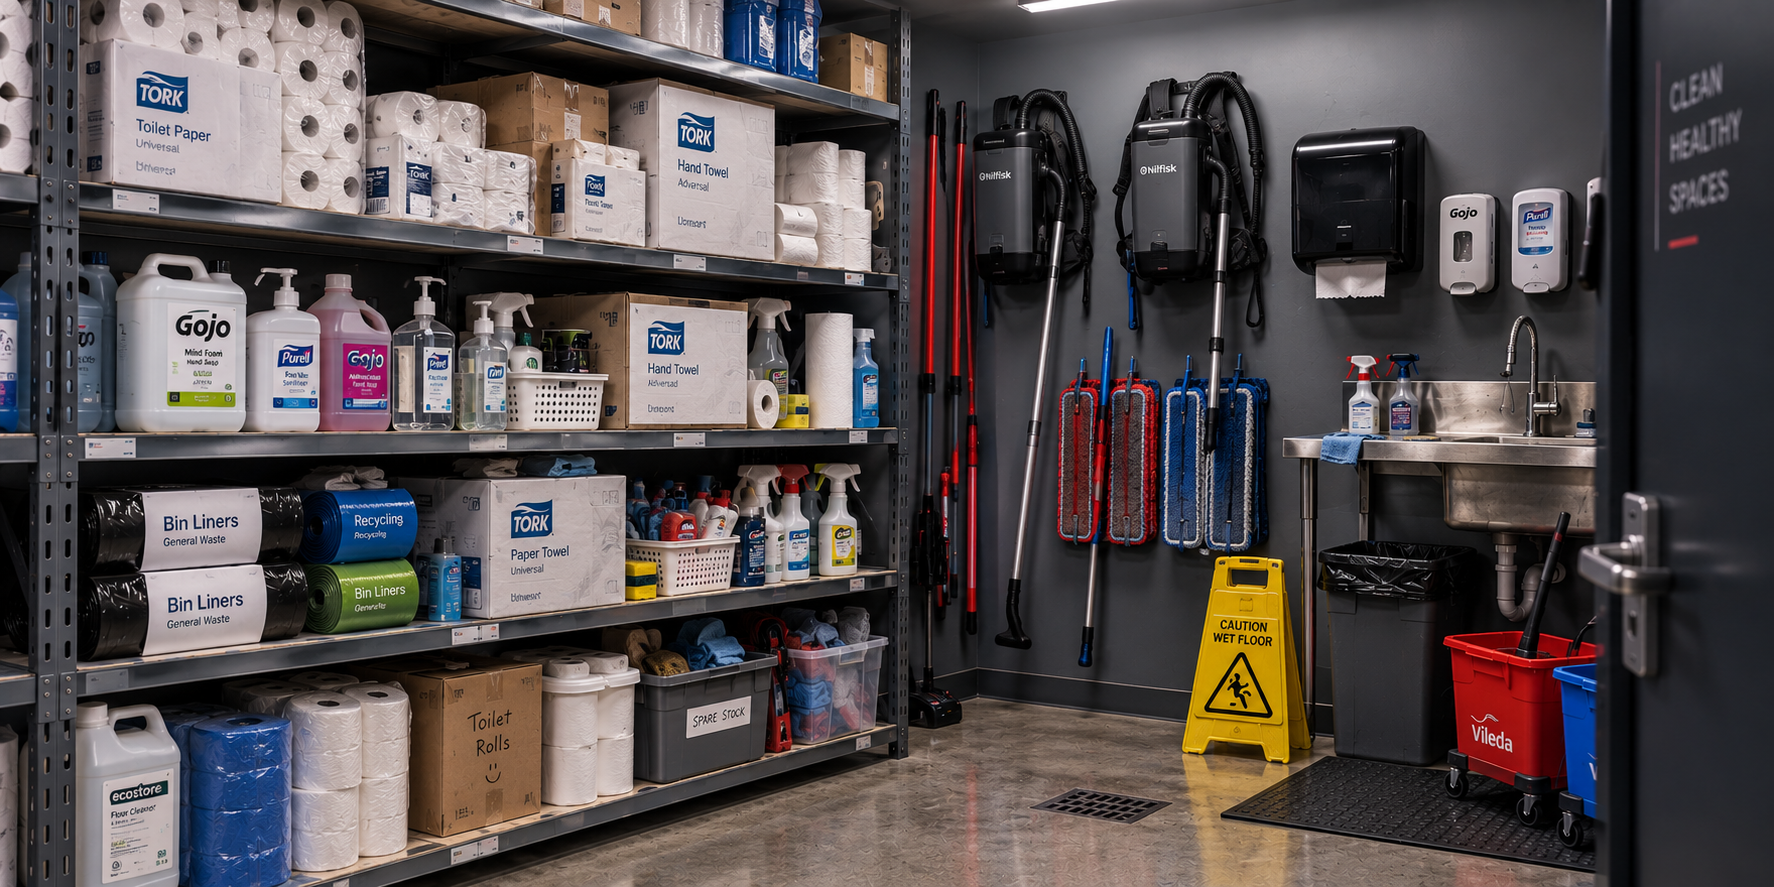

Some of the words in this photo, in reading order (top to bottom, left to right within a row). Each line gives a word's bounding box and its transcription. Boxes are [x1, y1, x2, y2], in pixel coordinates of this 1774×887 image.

[139, 83, 185, 108] TORK
[1669, 61, 1723, 112] CLEAN
[135, 118, 171, 137] Toilet
[174, 124, 212, 143] Paper
[680, 124, 713, 147] TORK
[1669, 107, 1743, 163] HEALTHY
[135, 138, 180, 154] Universal
[677, 158, 702, 174] Hand
[703, 163, 729, 179] Towel
[985, 170, 1012, 181] Nilfisk
[1147, 163, 1177, 175] Nilfisk
[1669, 168, 1729, 214] SPACES
[1449, 206, 1478, 220] Gojo
[175, 313, 231, 343] Gojo
[649, 332, 682, 350] TORK
[281, 350, 310, 364] Purell
[647, 362, 672, 375] Hand
[674, 363, 700, 376] Towel
[163, 516, 189, 532] Bin
[193, 514, 239, 531] Liners
[353, 512, 404, 528] Recycling
[513, 513, 550, 533] TORK
[163, 536, 198, 547] General
[199, 534, 226, 545] Waste
[510, 548, 540, 561] Paper
[541, 545, 570, 559] Towel
[510, 564, 545, 576] Universal
[354, 586, 372, 600] Bin
[374, 584, 406, 598] Liners
[167, 597, 193, 614] Bin
[197, 593, 244, 611] Liners
[166, 619, 202, 630] General
[203, 614, 231, 626] Waste
[1219, 619, 1268, 633] CAUTION
[1212, 632, 1236, 644] WET
[1237, 634, 1273, 647] FLOOR
[467, 708, 513, 732] Toilet
[692, 711, 718, 728] SPARE
[722, 706, 746, 721] STOCK
[476, 734, 510, 757] Rolls
[1471, 723, 1514, 753] Vileda
[112, 783, 163, 802] ecostore
